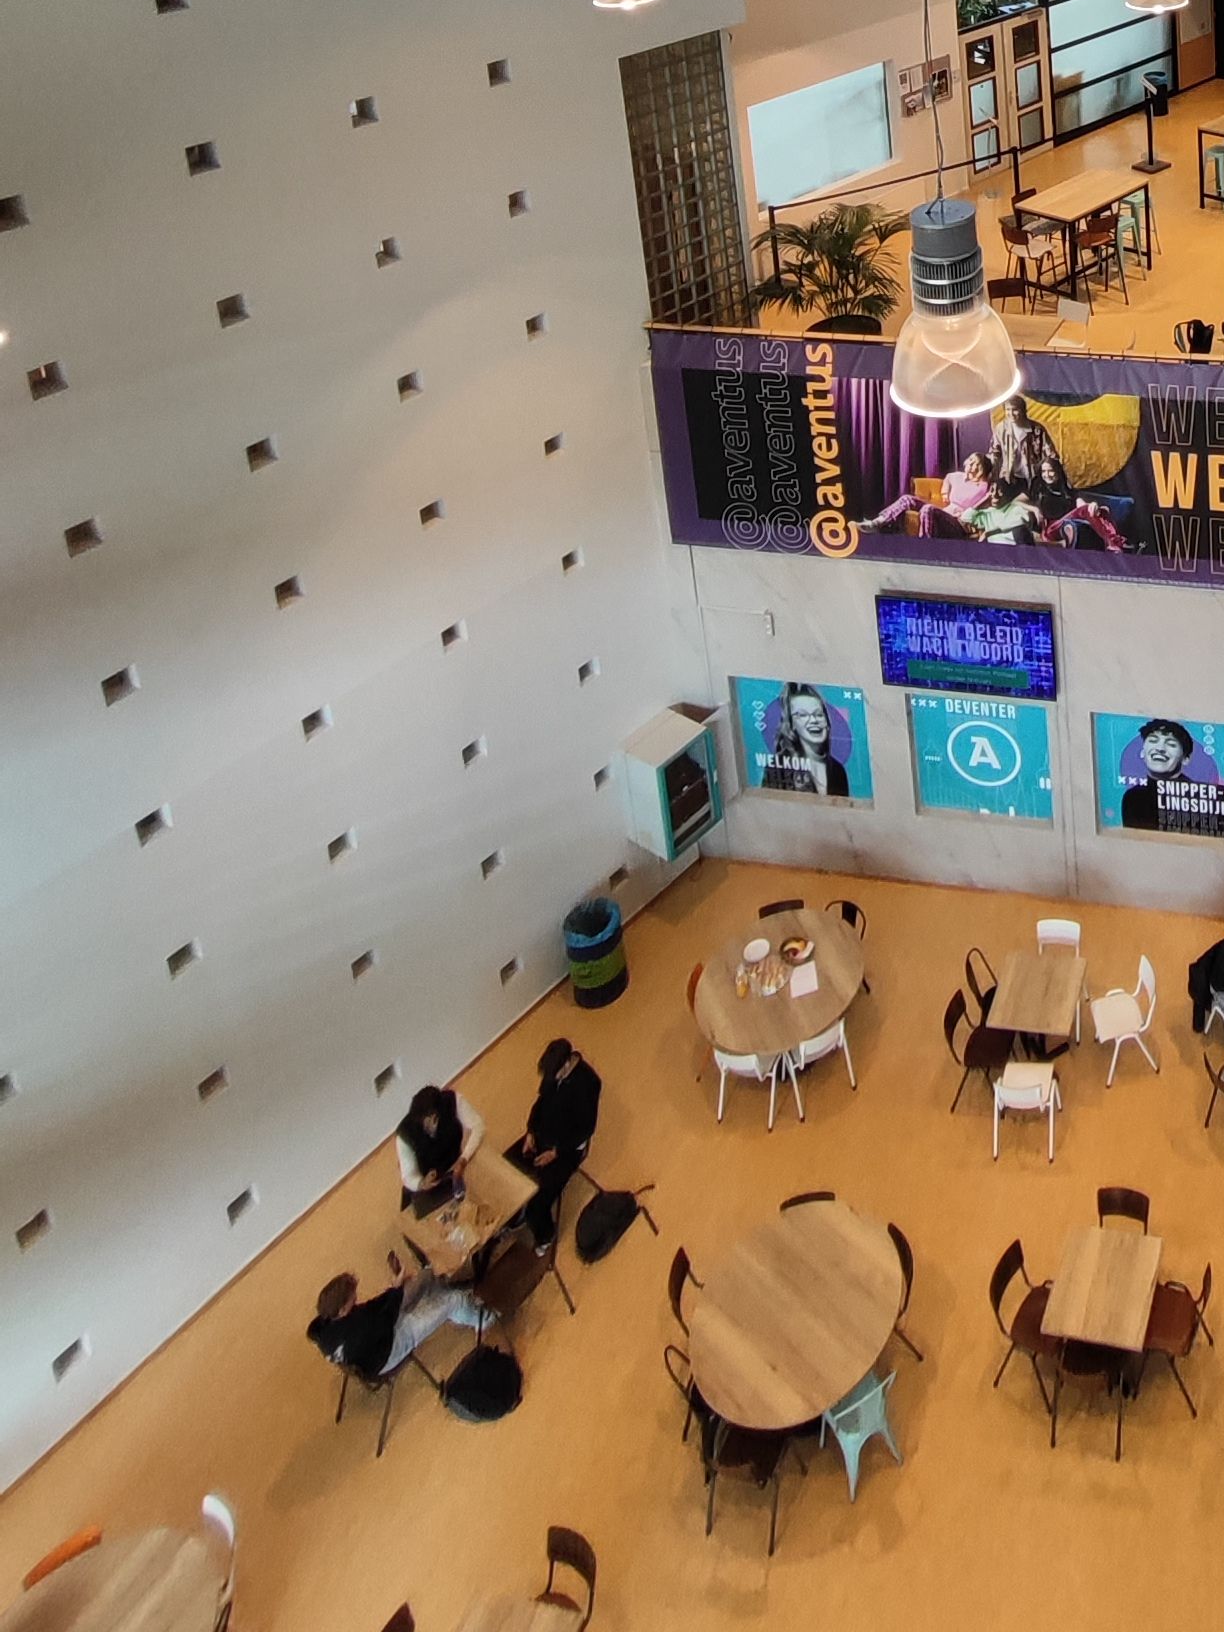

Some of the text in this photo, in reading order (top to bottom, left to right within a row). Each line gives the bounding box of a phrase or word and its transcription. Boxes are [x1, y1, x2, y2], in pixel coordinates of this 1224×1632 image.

[710, 338, 770, 550] @aventus
[755, 340, 813, 555] @aventus
[801, 342, 859, 558] @aventus
[906, 617, 959, 638] NIEUW
[945, 698, 1016, 719] DEVENTER
[755, 752, 812, 772] WELKOM
[968, 735, 1002, 770] A
[1156, 779, 1224, 800] SNIPPER-
